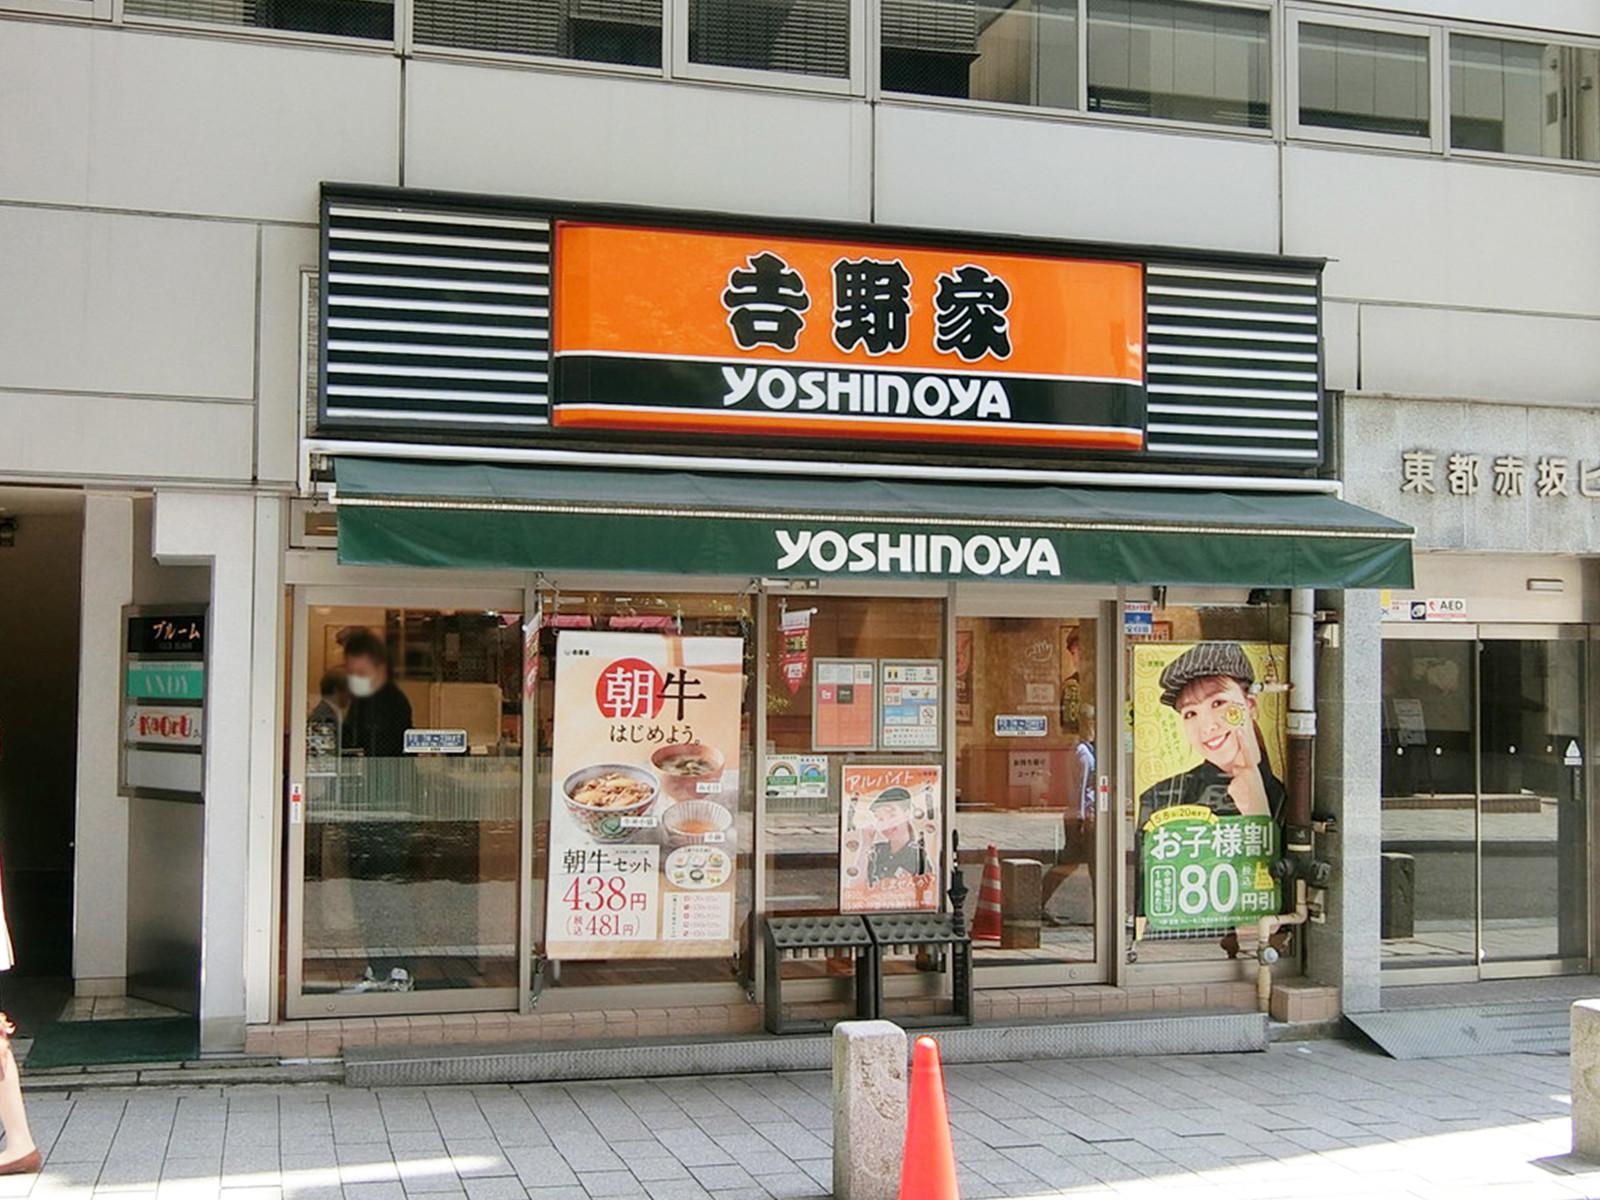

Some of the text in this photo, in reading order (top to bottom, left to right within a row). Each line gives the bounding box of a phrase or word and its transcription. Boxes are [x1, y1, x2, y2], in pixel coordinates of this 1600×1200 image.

[721, 366, 1012, 419] YOSHINOYA
[774, 529, 1062, 577] YOSHINOYA
[1440, 600, 1463, 611] AED
[153, 620, 201, 641] ブルーム
[602, 666, 708, 722] 朝牛
[846, 770, 914, 791] アルバイト
[1150, 822, 1274, 861] お子様割
[562, 849, 652, 875] 朝牛セット
[562, 875, 647, 912] 438円
